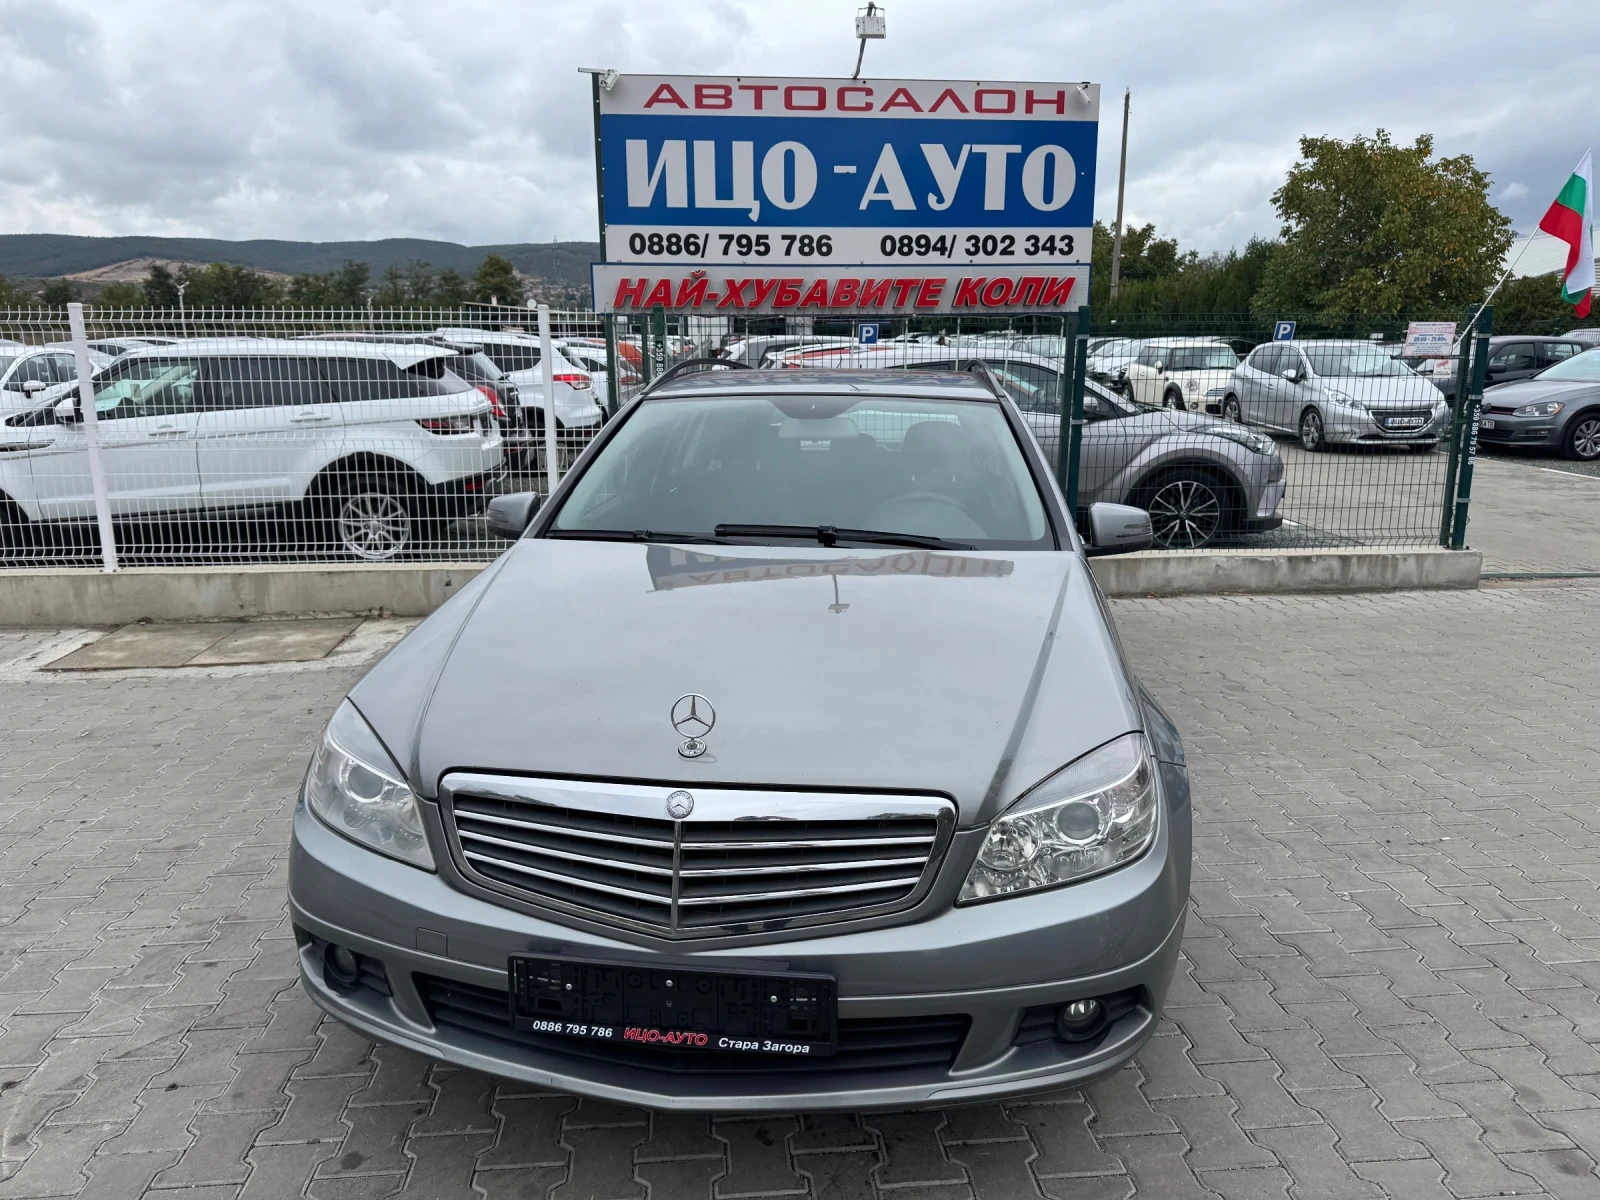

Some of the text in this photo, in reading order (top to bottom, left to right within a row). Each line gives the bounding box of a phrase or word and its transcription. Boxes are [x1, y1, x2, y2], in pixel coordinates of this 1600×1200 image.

[643, 83, 1066, 115] АВТОСАЛОН
[628, 232, 1074, 259] 0886/ 795 786 0894/ 302 343
[612, 270, 1076, 309] НАЙ-ХУБАВИТЕ КОЛИ
[861, 326, 875, 342] P
[1277, 323, 1291, 339] P
[655, 342, 664, 361] +359
[1467, 403, 1481, 465] +359 886 79 57 86
[532, 1020, 810, 1054] 0886 795 786 ИЦО-АУТО Стара Загора
